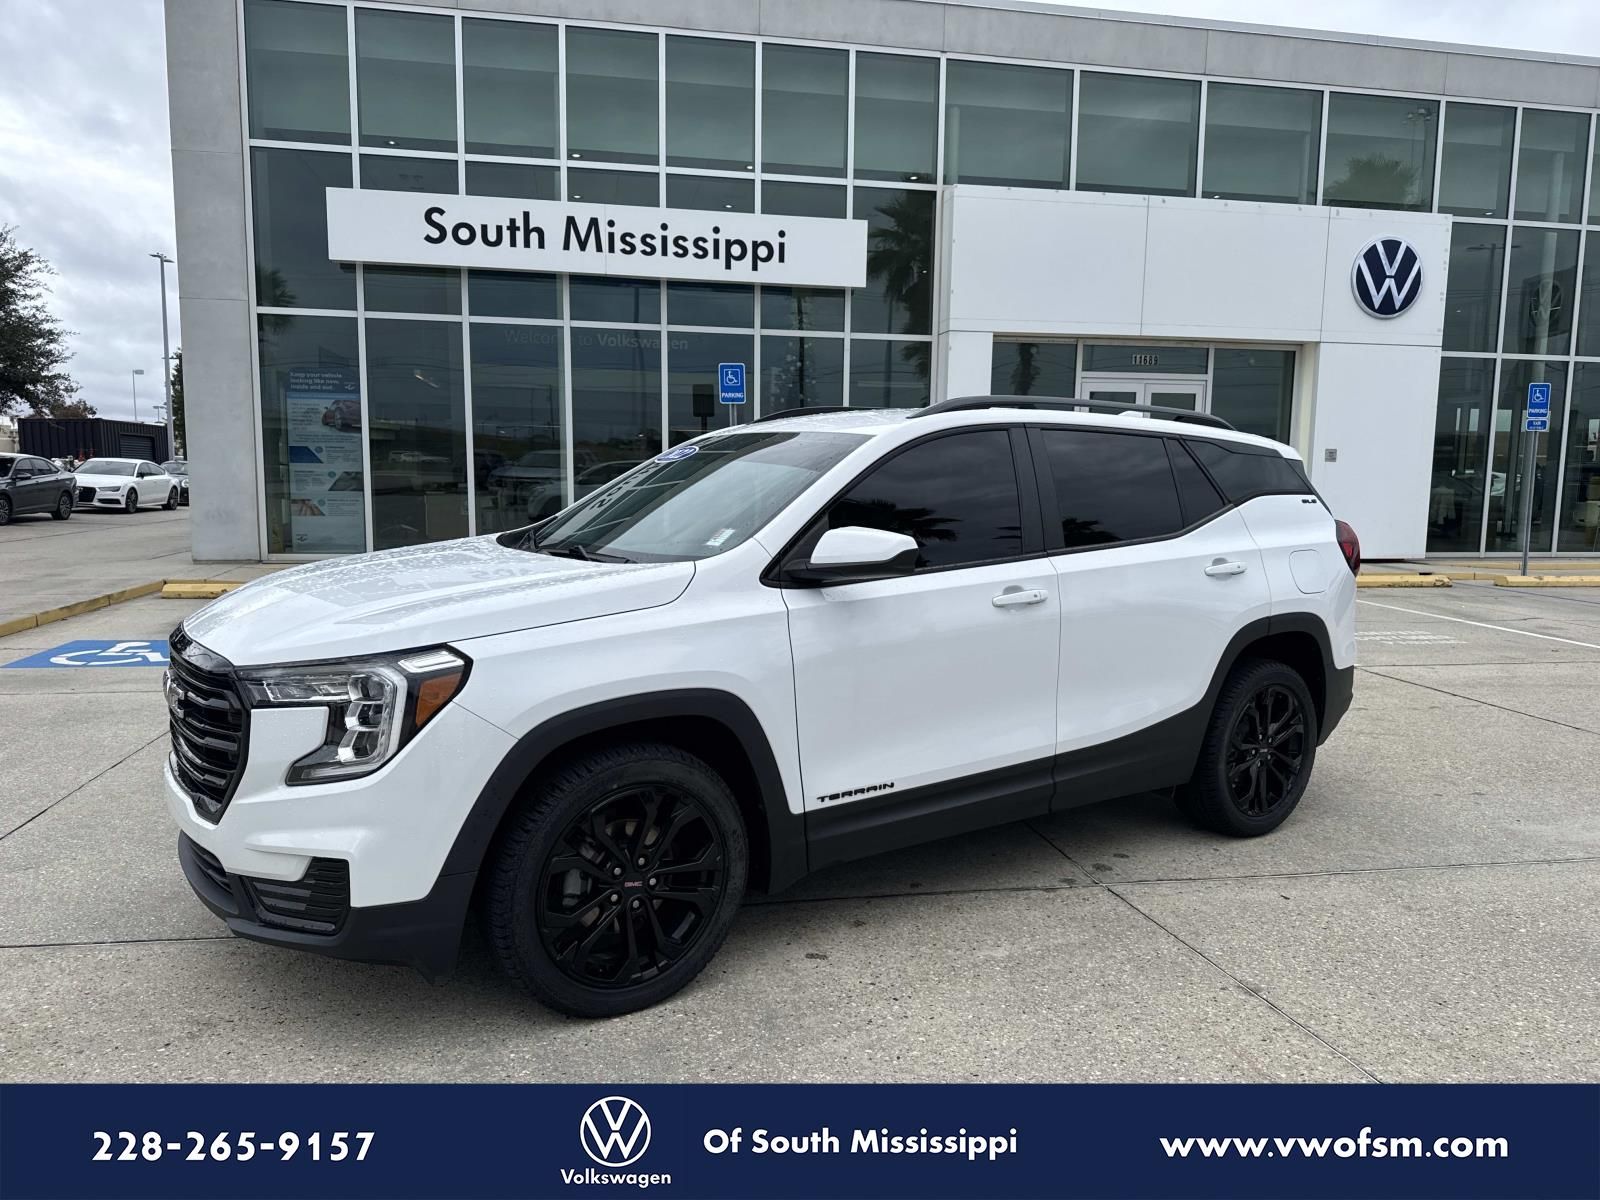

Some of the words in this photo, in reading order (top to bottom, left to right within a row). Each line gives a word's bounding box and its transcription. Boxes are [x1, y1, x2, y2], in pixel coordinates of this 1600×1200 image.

[423, 206, 546, 250] South
[562, 214, 787, 272] Mississippi
[578, 333, 593, 347] to
[597, 333, 689, 350] Volkswaen
[1133, 354, 1159, 366] 11689
[816, 782, 895, 803] TERRAIN
